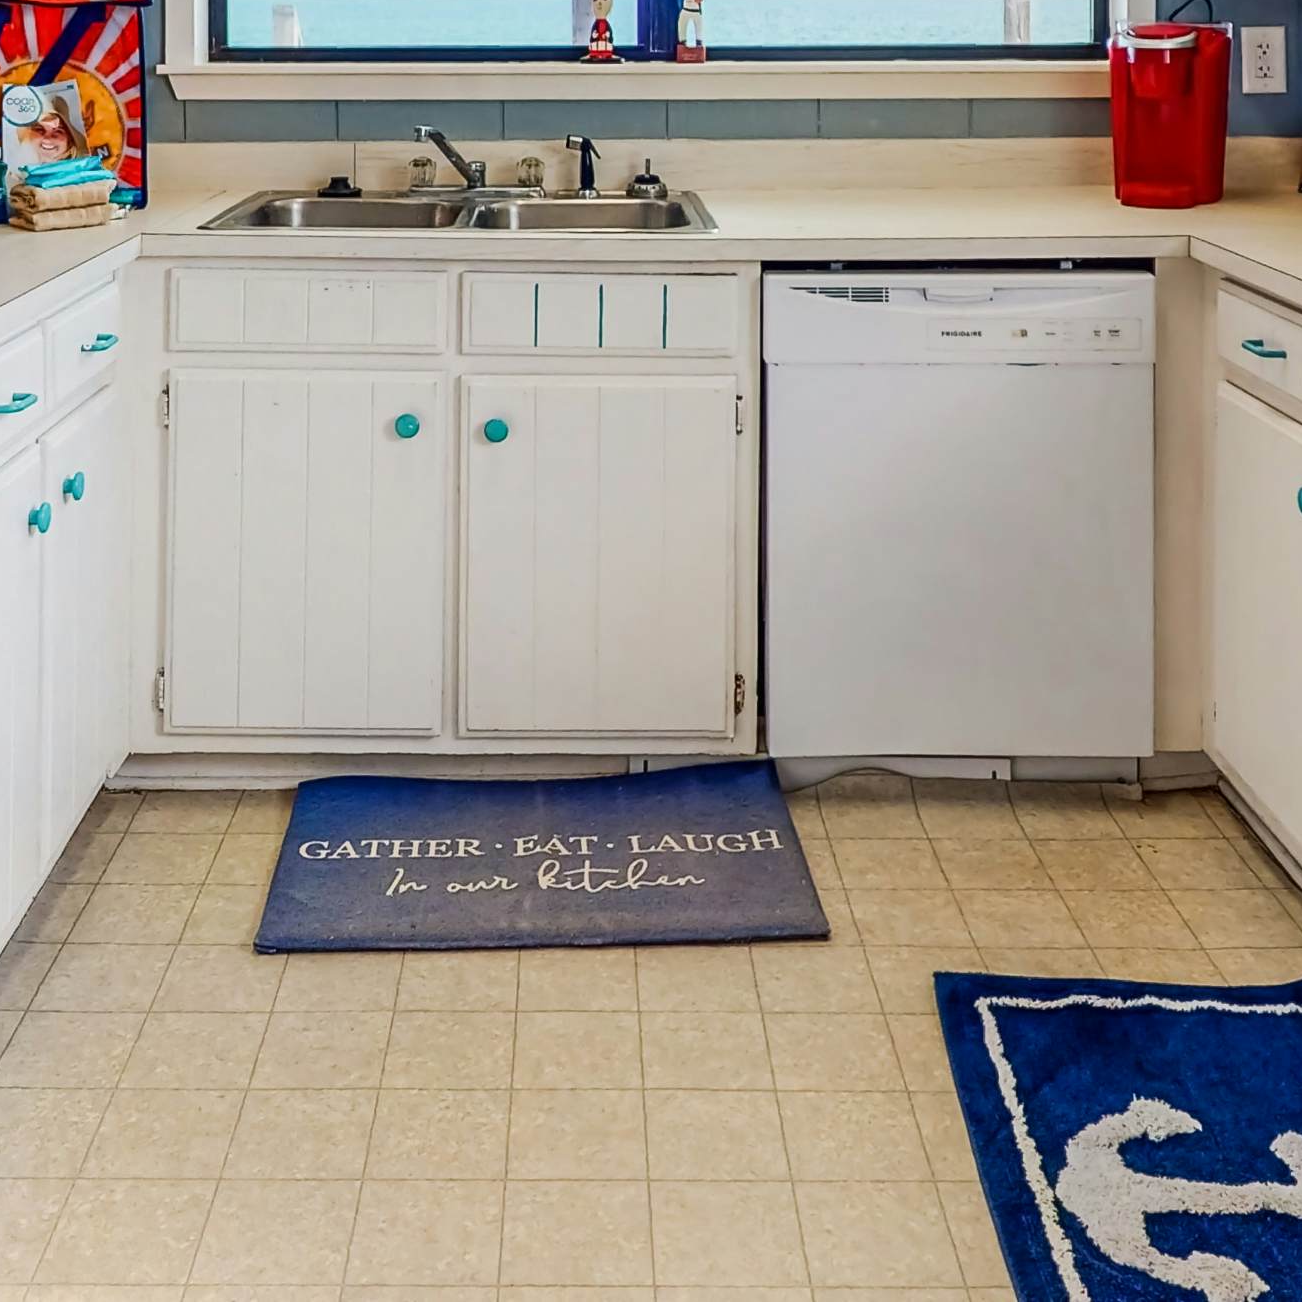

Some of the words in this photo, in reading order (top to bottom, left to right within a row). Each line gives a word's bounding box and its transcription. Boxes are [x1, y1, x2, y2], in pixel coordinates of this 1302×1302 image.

[941, 330, 982, 338] FRIGIDAIRE
[298, 838, 486, 859] GATHER
[513, 833, 599, 857] EAT
[627, 829, 785, 854] LAUGH
[386, 867, 427, 897] In
[446, 875, 518, 893] our
[537, 858, 706, 895] kitchen
